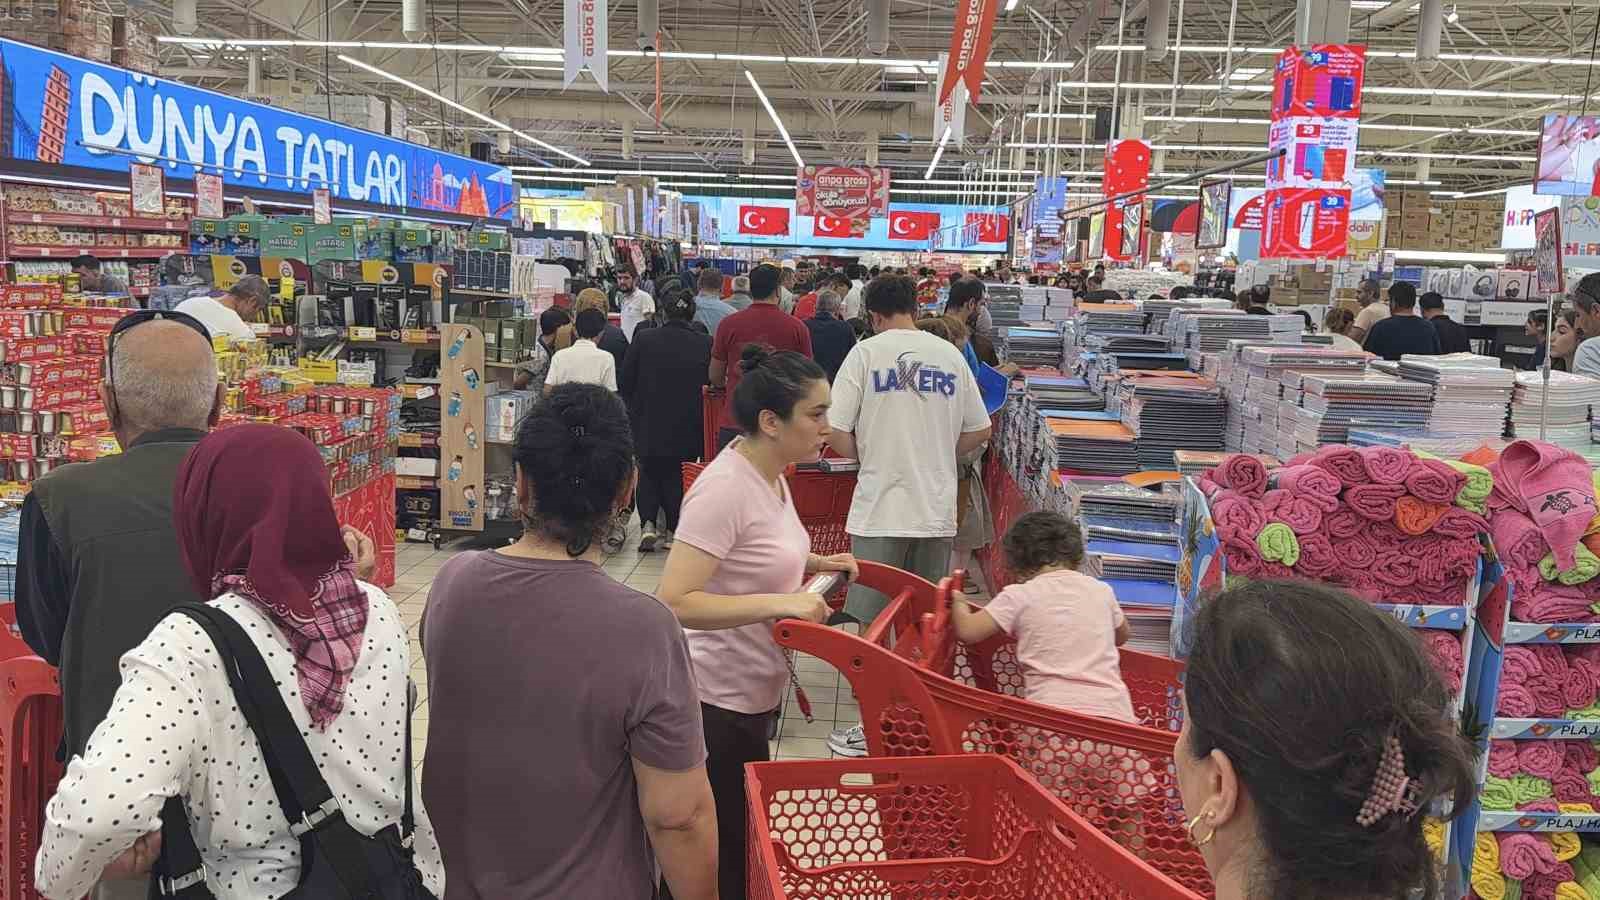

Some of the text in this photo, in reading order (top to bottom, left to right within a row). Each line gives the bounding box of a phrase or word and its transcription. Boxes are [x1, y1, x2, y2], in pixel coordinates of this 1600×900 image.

[956, 28, 973, 71] anpa
[80, 72, 269, 184] DÜNYA
[276, 126, 407, 207] TATLARI
[819, 175, 868, 186] anpa gross
[1326, 196, 1338, 206] 39
[1506, 208, 1535, 226] HiPP
[872, 358, 957, 400] LAKERS
[1560, 724, 1599, 736] PLAJ
[1547, 817, 1584, 829] PLAJ
